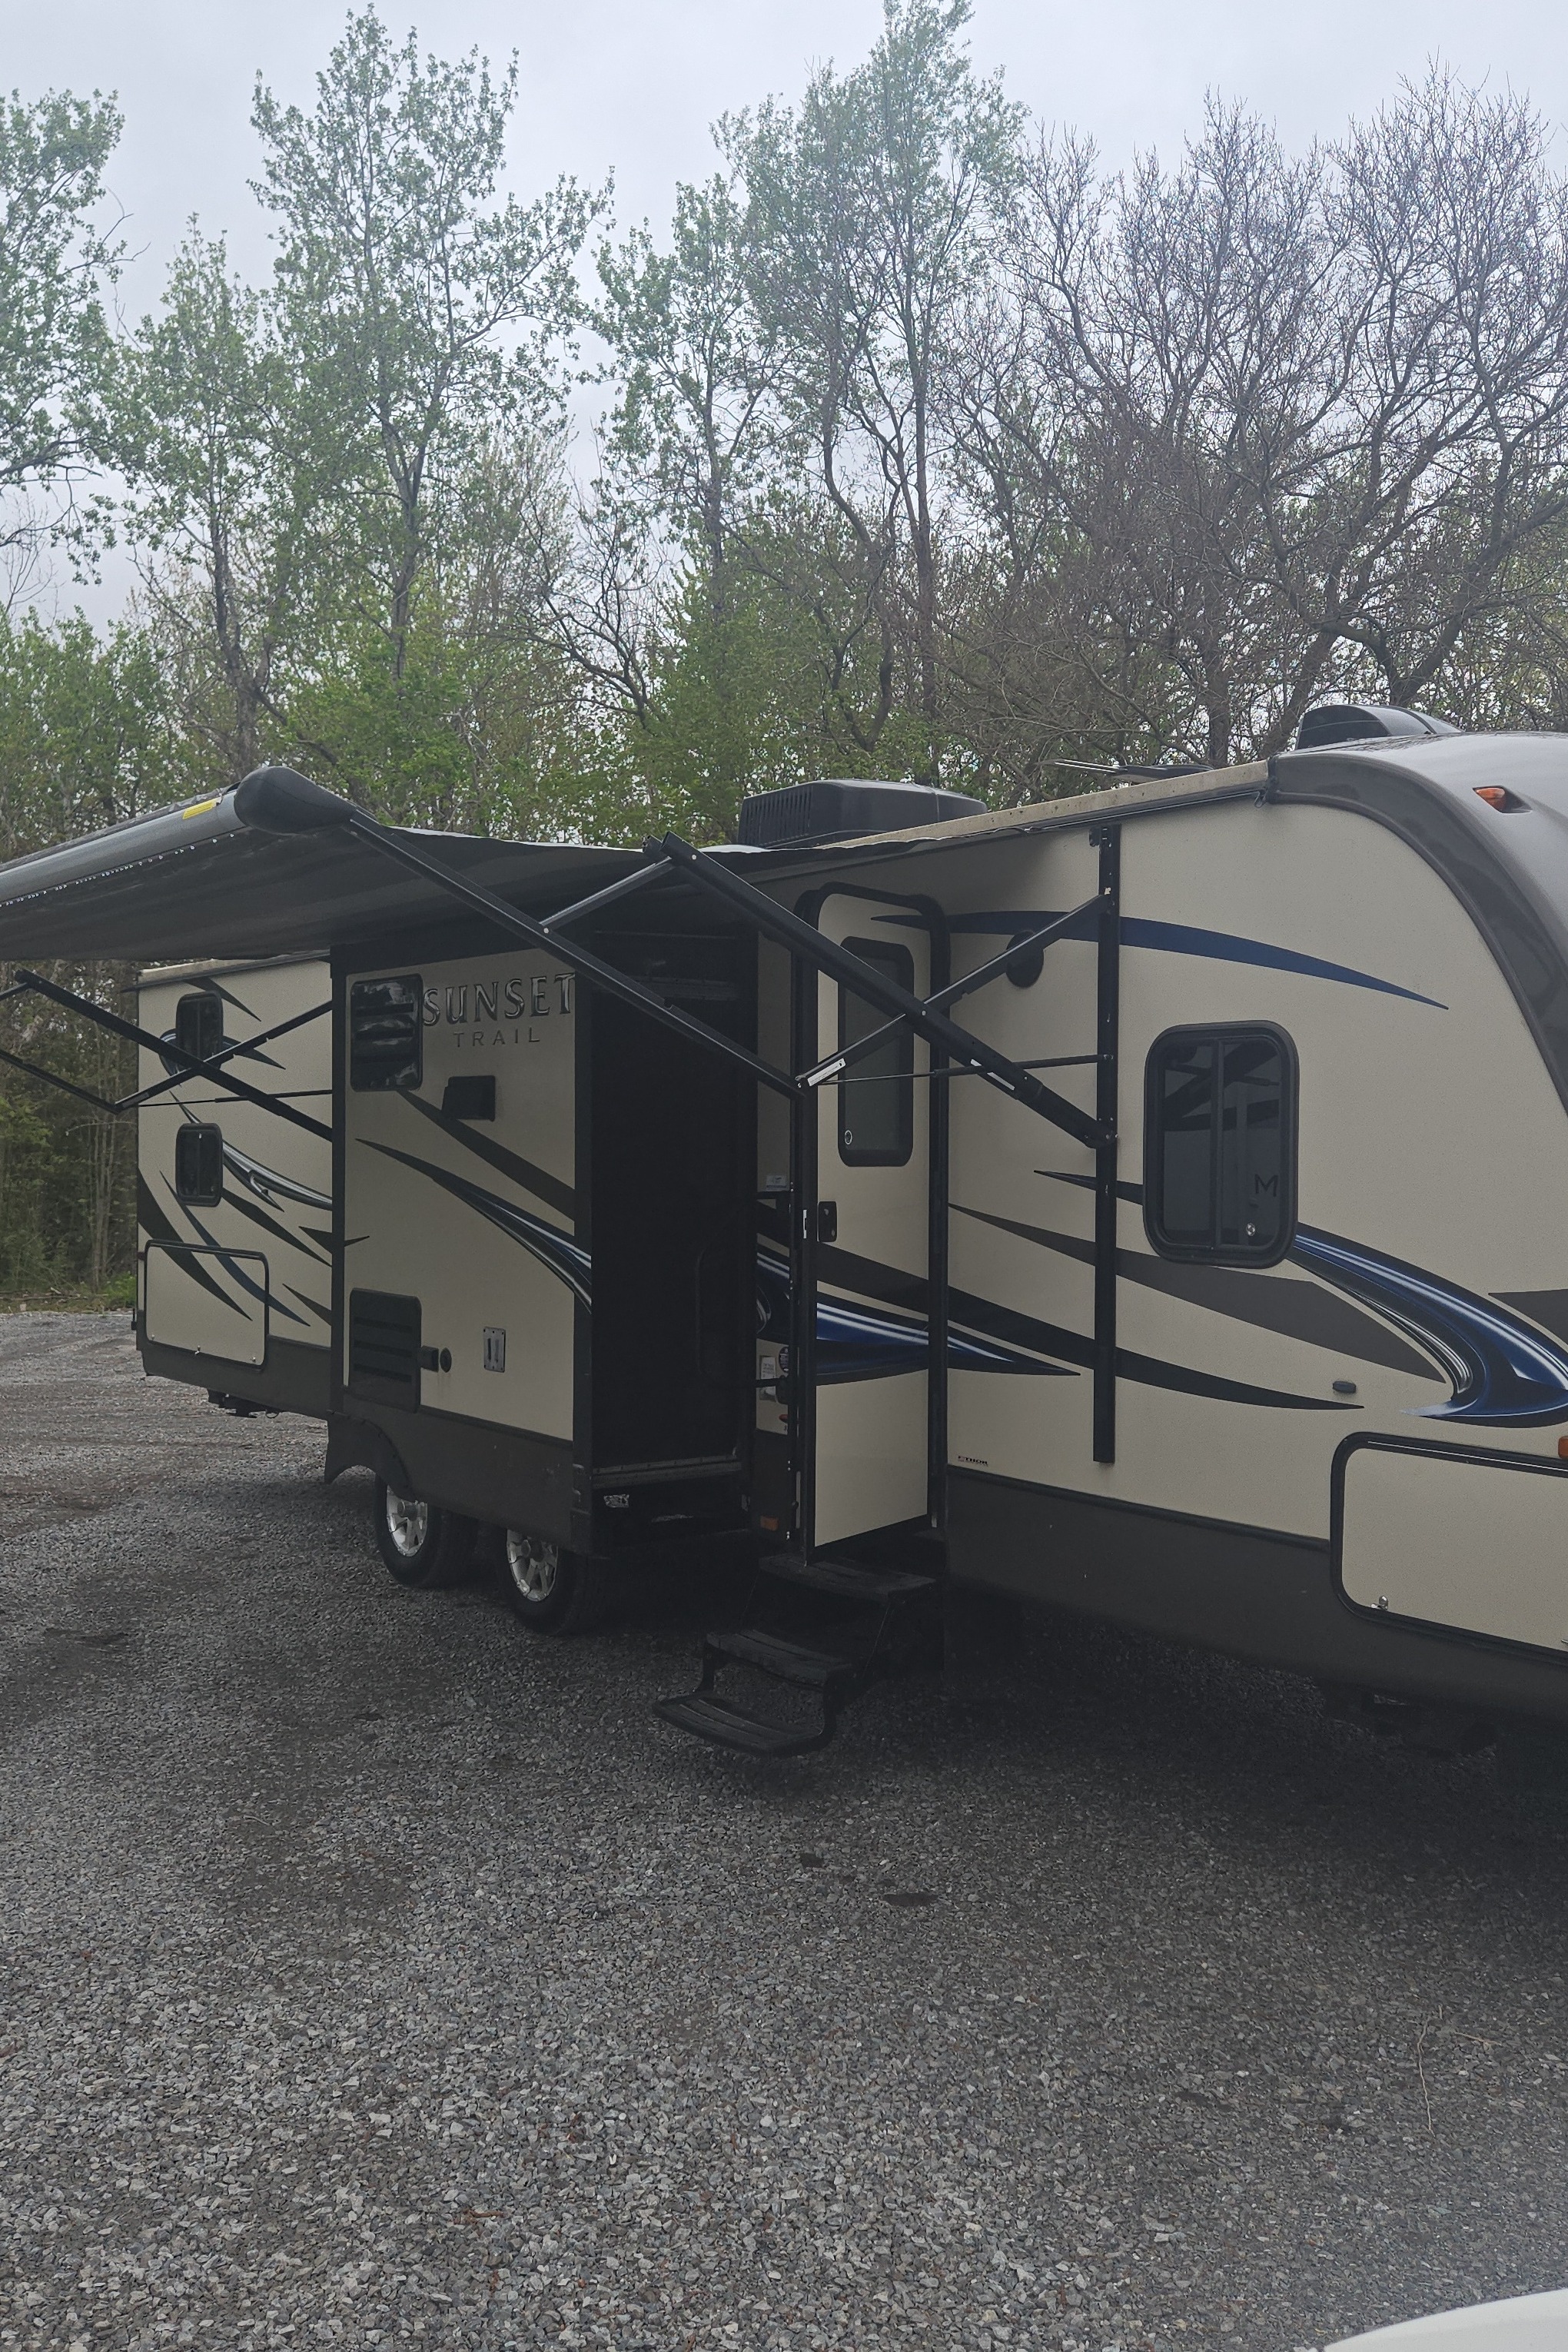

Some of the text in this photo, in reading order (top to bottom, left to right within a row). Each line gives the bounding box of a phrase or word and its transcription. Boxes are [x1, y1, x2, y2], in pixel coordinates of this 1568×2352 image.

[423, 972, 575, 1027] SUNSET
[453, 1027, 540, 1047] TRAIL
[1254, 1174, 1278, 1198] M
